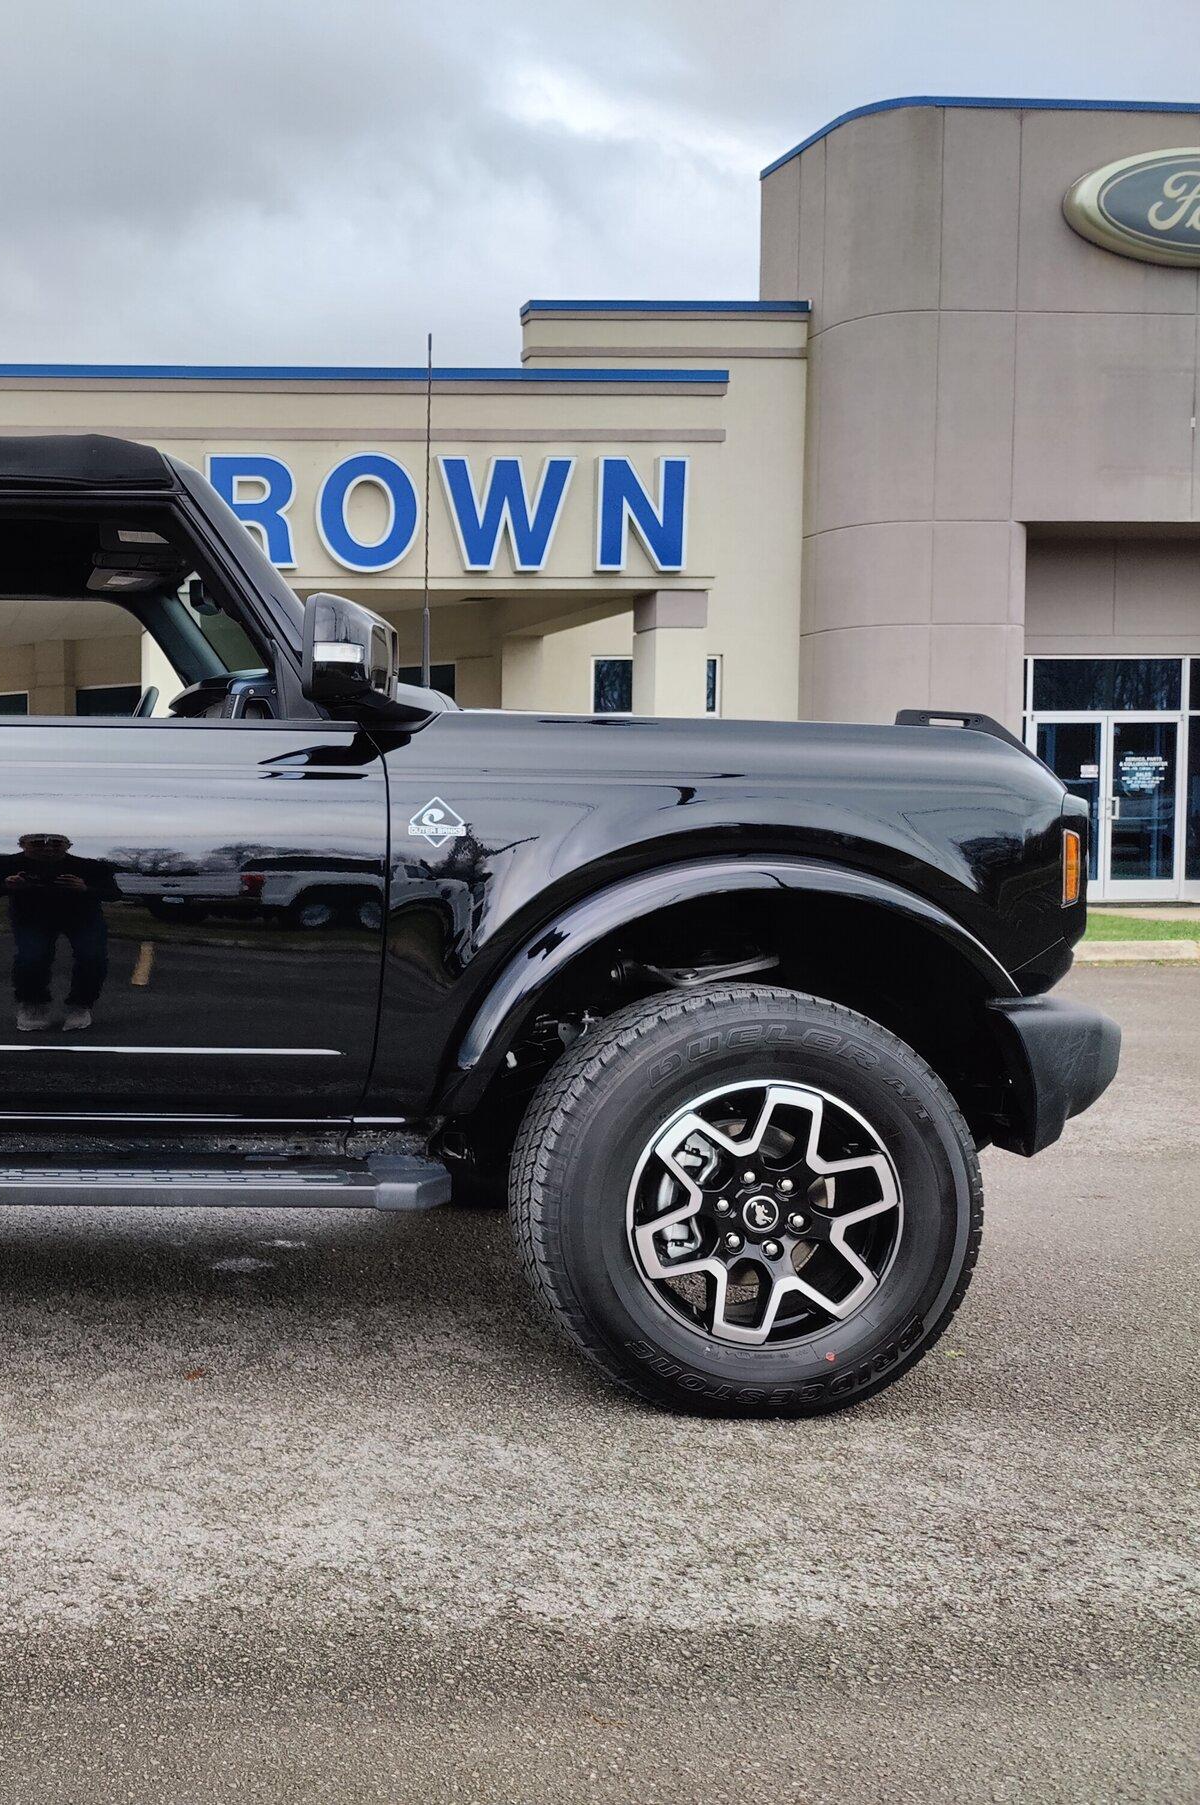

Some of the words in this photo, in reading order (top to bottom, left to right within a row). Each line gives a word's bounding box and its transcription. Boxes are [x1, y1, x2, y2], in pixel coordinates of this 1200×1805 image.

[649, 1023, 880, 1089] DUELER
[882, 1076, 937, 1125] A/T
[623, 1313, 926, 1406] BRIDGESTONE
